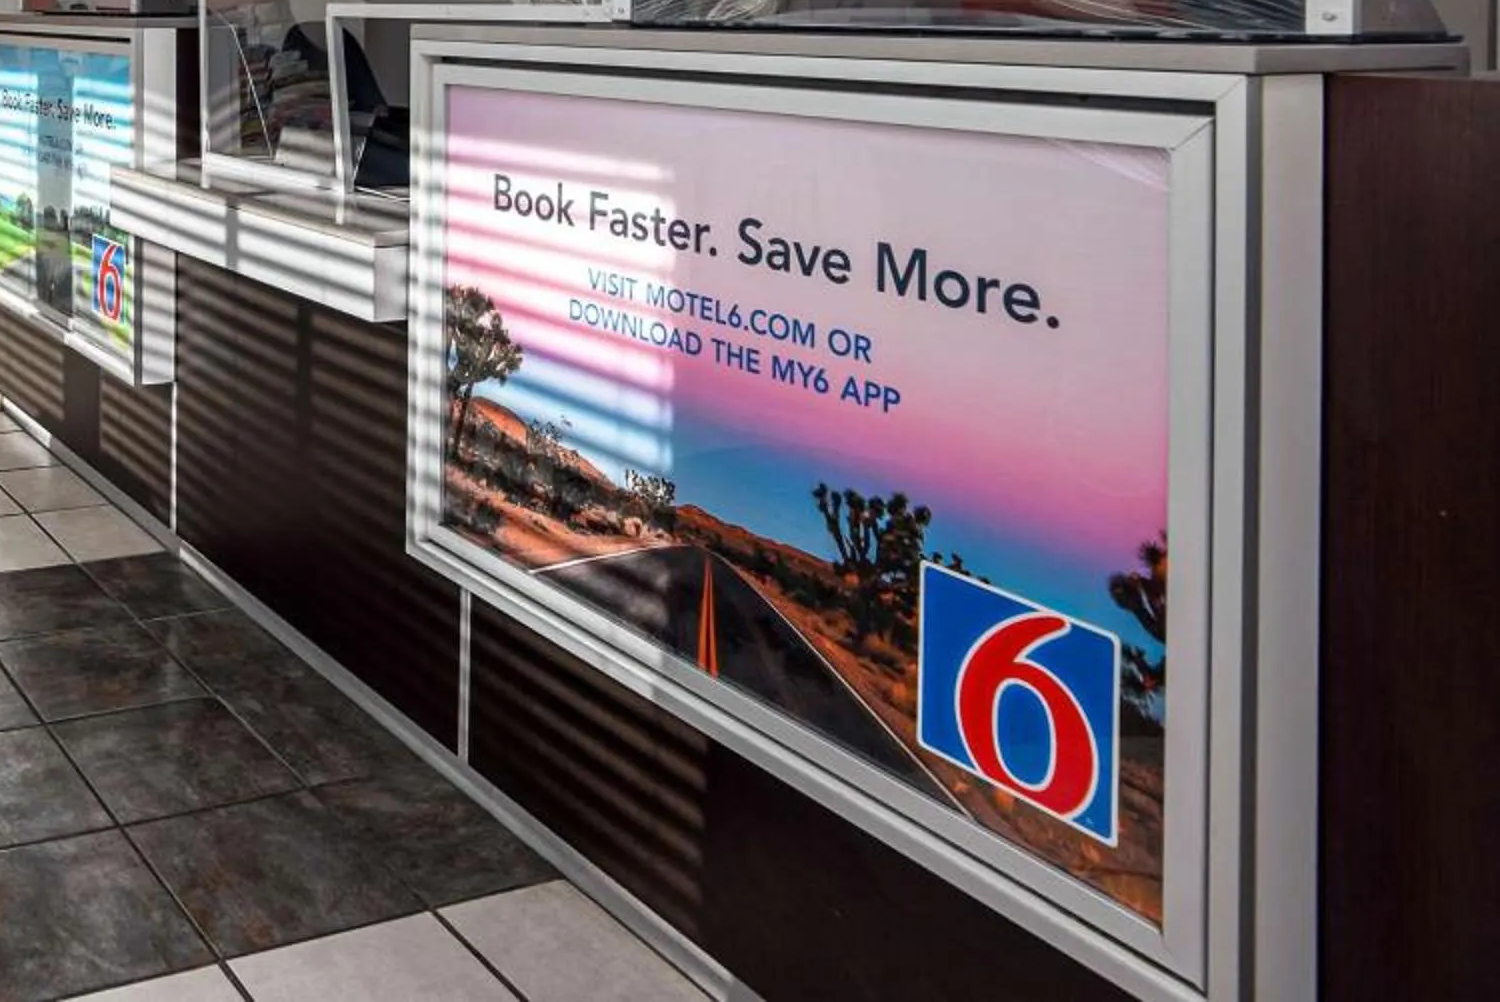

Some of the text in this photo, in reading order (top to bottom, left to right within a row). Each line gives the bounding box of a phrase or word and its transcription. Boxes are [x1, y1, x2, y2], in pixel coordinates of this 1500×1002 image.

[97, 242, 123, 322] 6
[493, 173, 1060, 330] Book Faster. Save More.
[568, 298, 902, 413] DOWNLOAD THE MY6 APP
[587, 266, 872, 364] VISIT MOTEL6.COM OR
[955, 610, 1099, 822] 6
